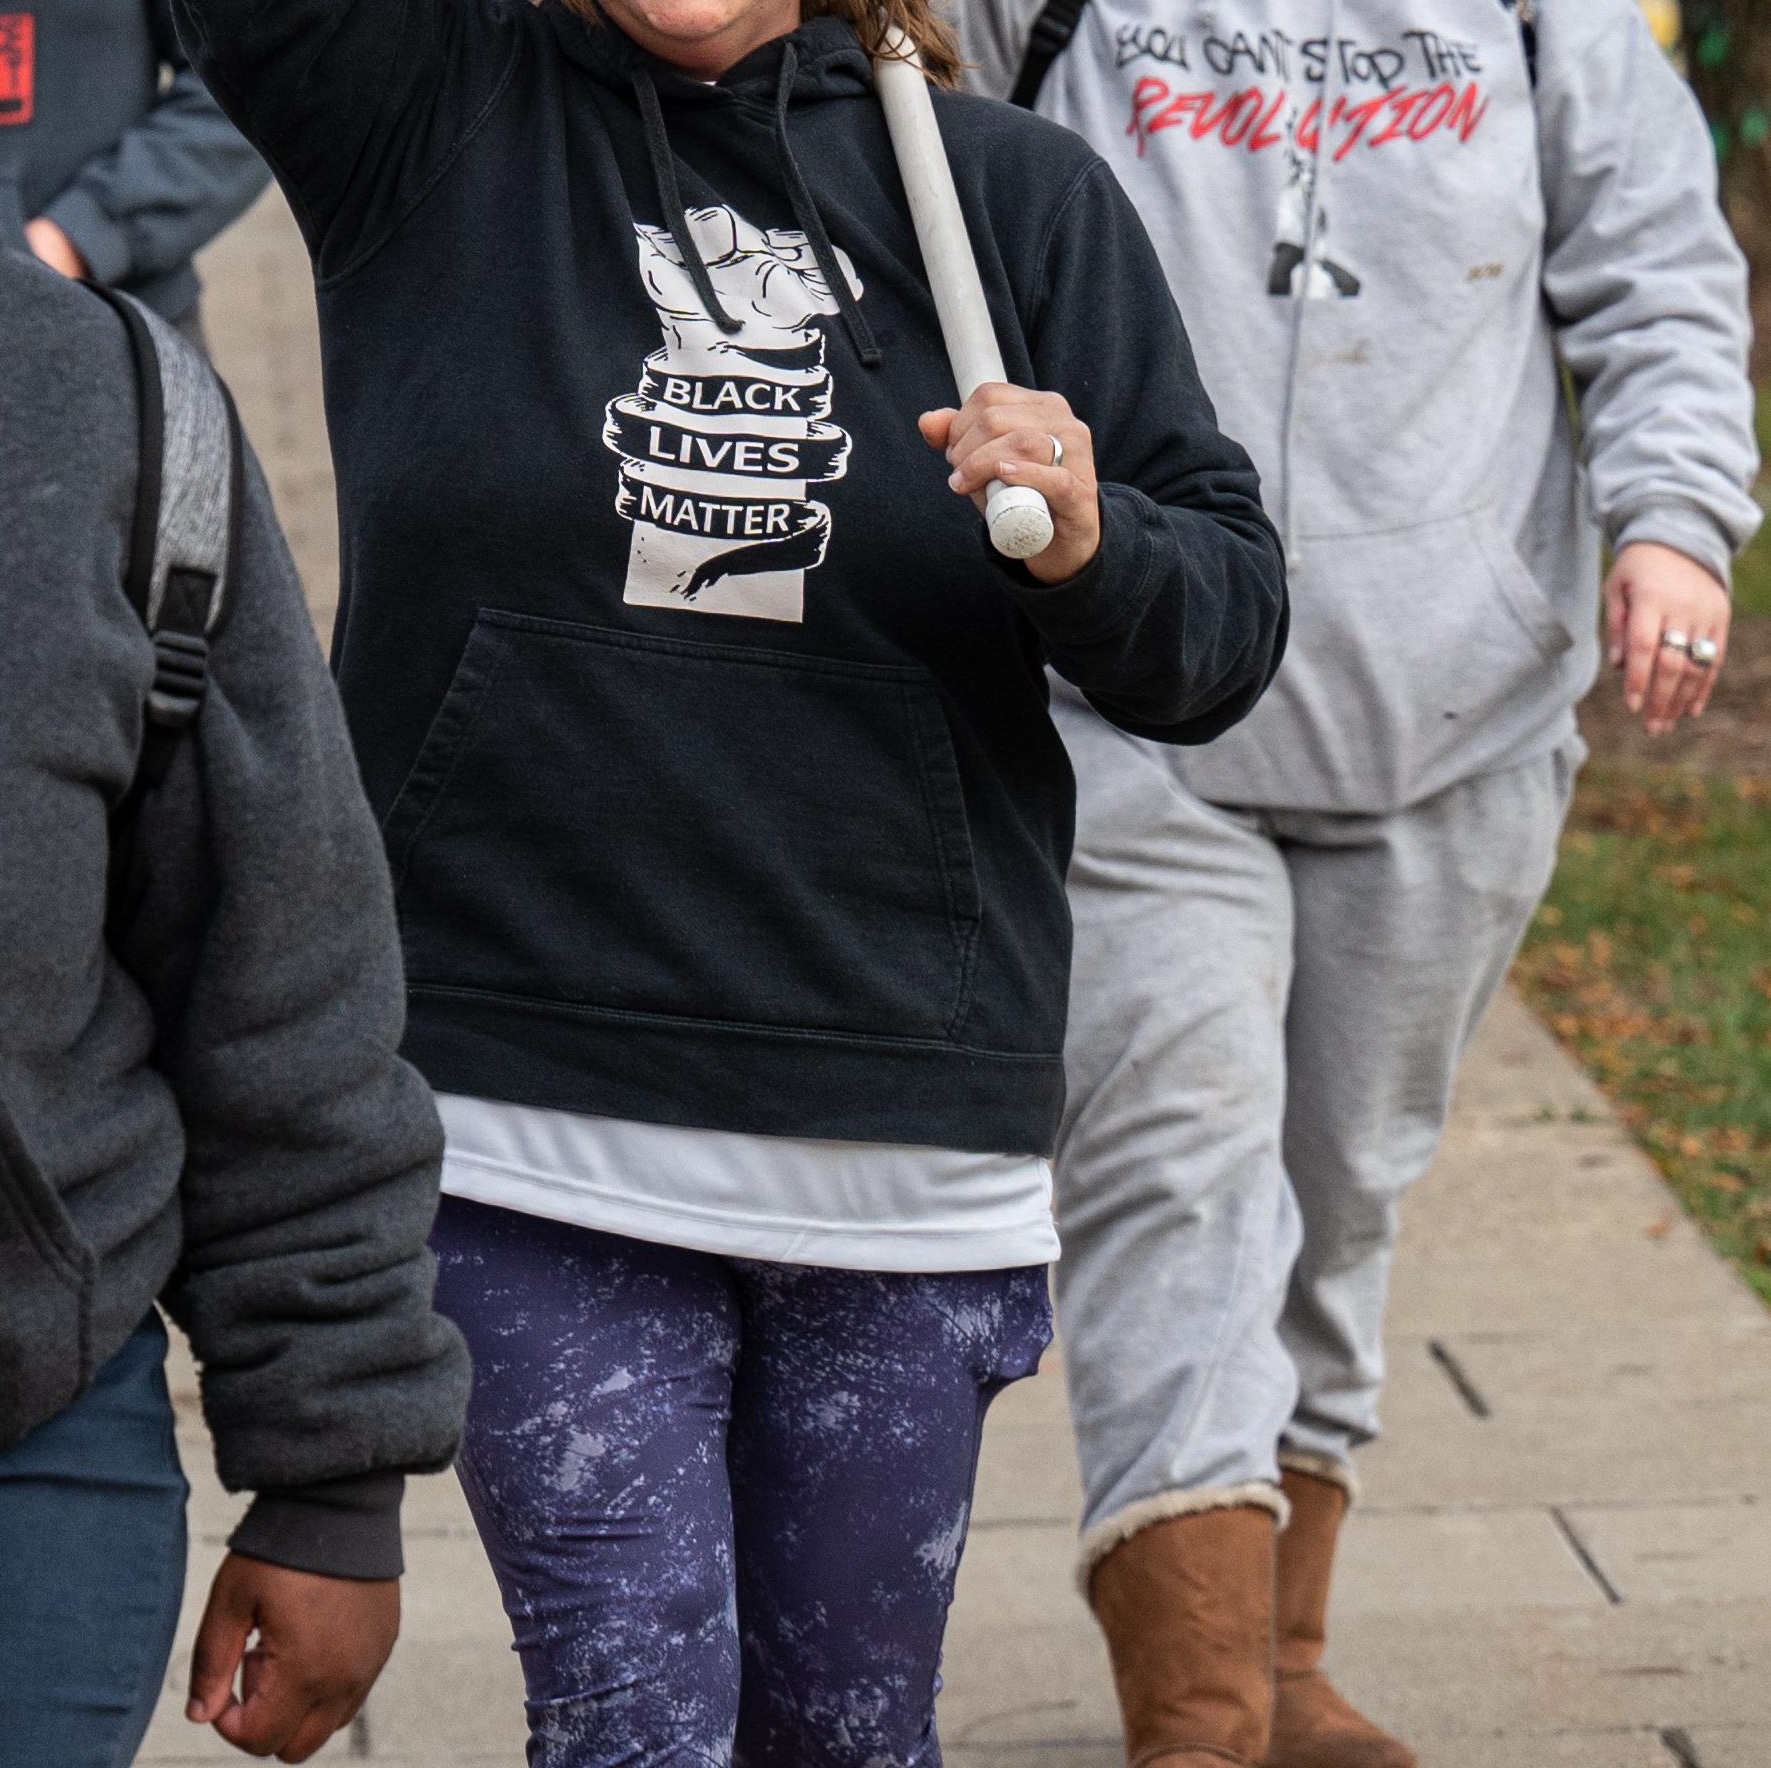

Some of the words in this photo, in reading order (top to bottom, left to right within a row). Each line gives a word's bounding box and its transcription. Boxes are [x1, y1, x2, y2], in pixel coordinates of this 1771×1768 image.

[1401, 31, 1482, 80] THE
[1126, 76, 1492, 164] REVOLUTION
[663, 376, 802, 413] BLACK
[647, 425, 801, 473] LIVES
[640, 485, 791, 535] MATTER
